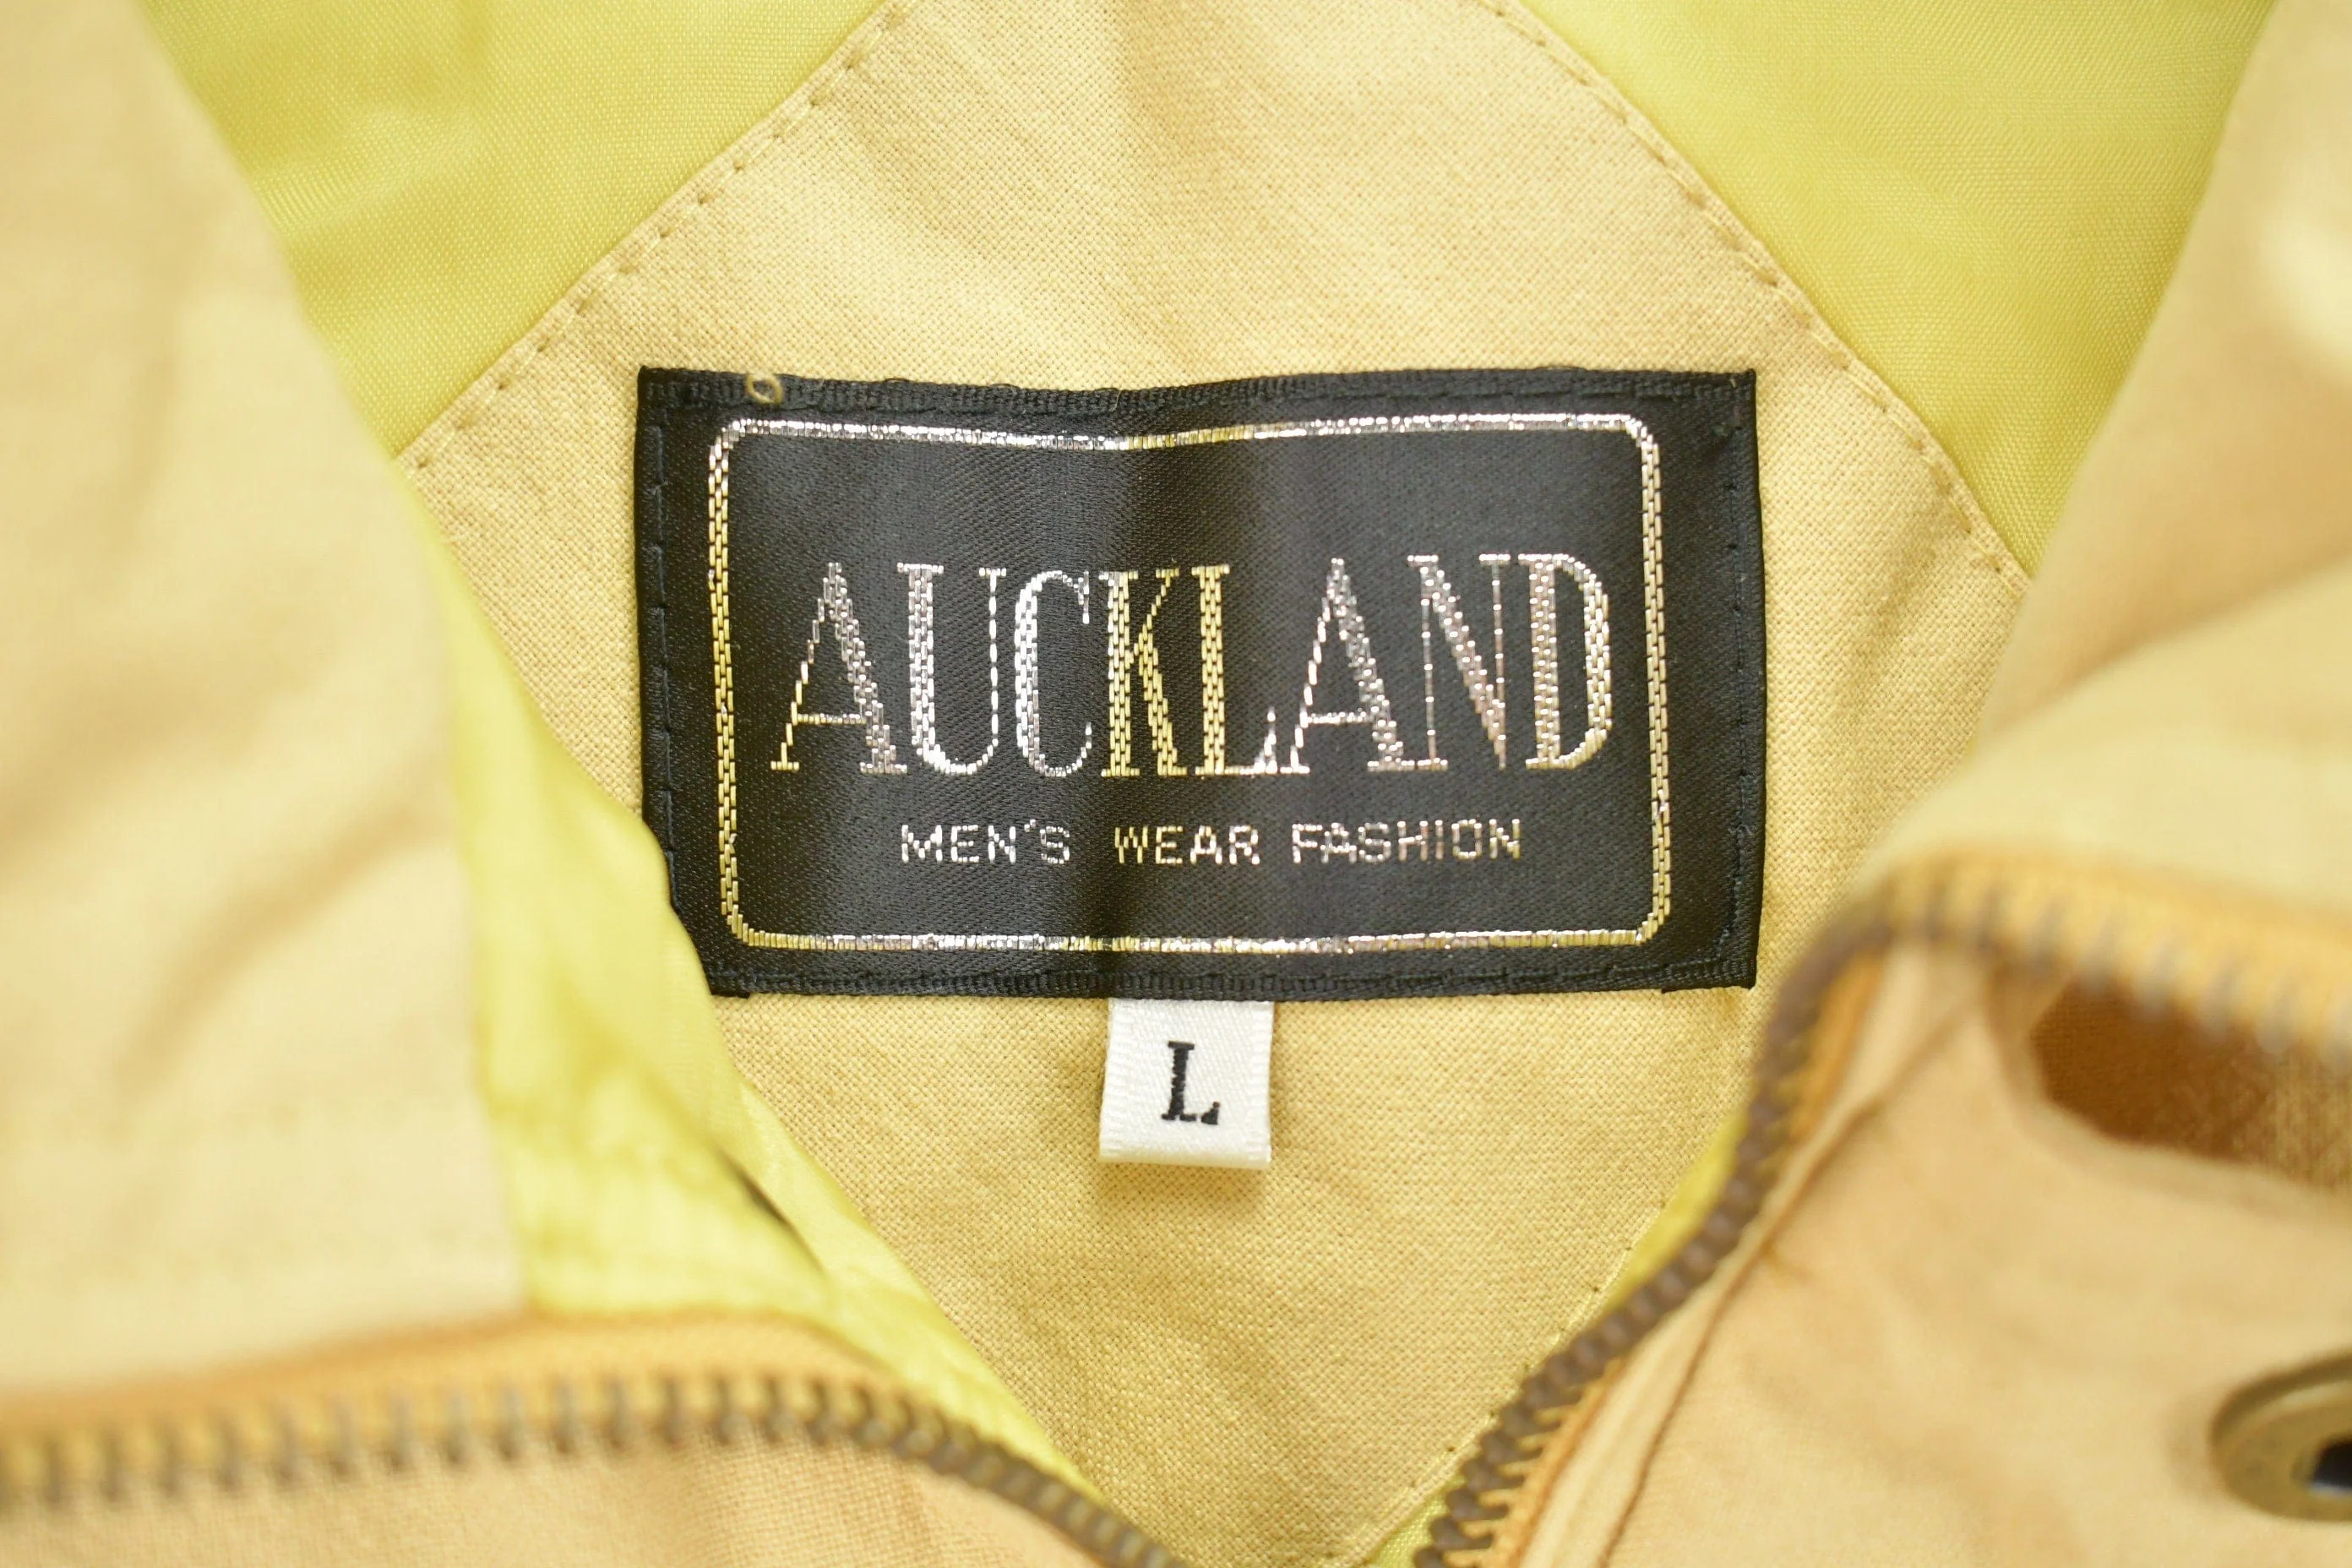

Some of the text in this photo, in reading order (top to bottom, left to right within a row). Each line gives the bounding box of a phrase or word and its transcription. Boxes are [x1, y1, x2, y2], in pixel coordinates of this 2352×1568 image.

[769, 553, 1613, 779] AUCKLAND
[901, 818, 1522, 866] MEN'S WEAR FASHION
[1161, 1040, 1221, 1125] L
